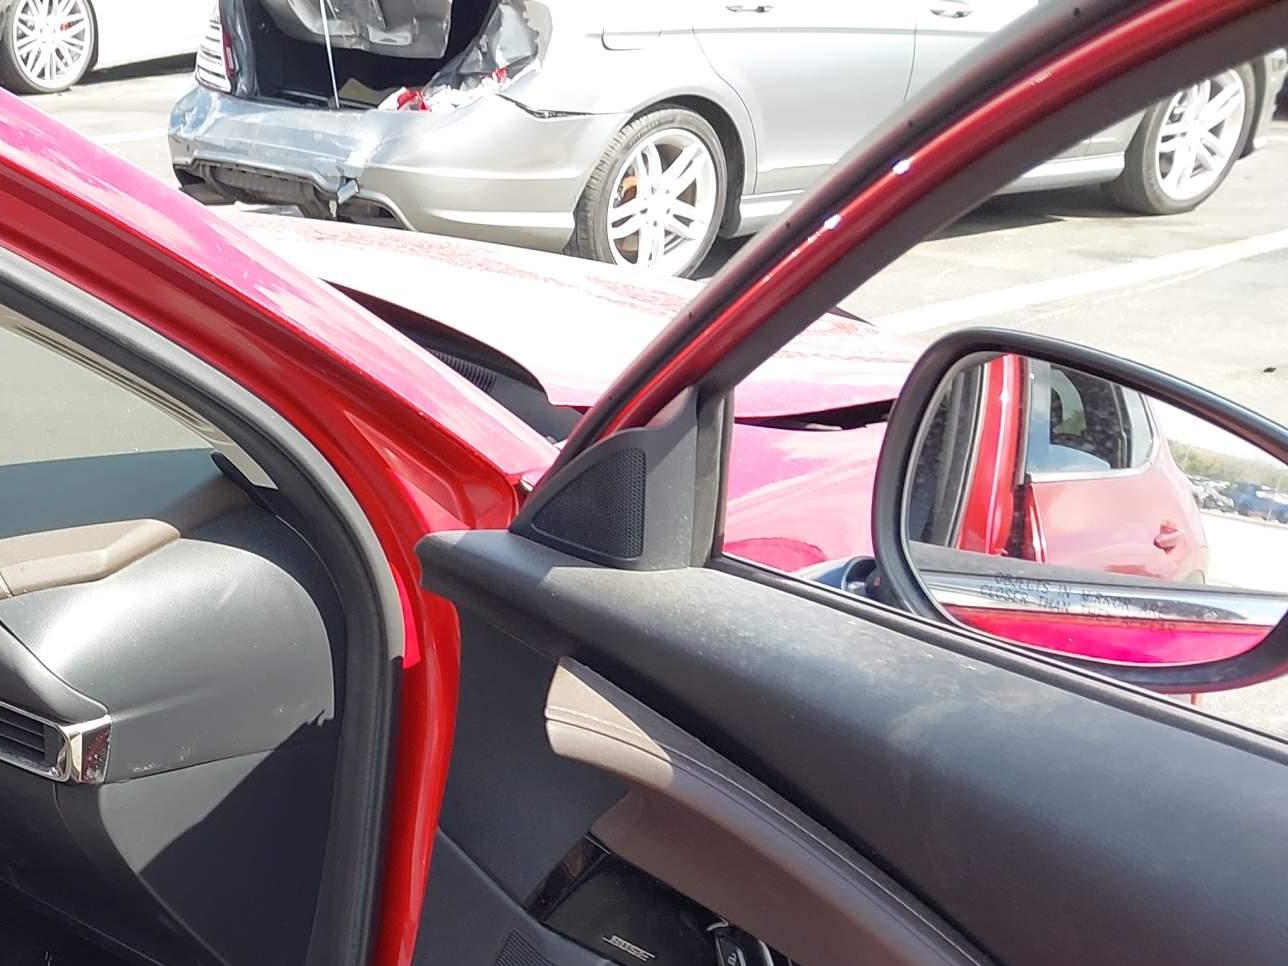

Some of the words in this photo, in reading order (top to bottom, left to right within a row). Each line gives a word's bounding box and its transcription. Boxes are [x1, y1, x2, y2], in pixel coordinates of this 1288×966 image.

[980, 584, 1029, 606] CLOSER
[1039, 594, 1072, 613] THAN
[995, 572, 1050, 593] OBJECTS
[1059, 584, 1072, 599] IN
